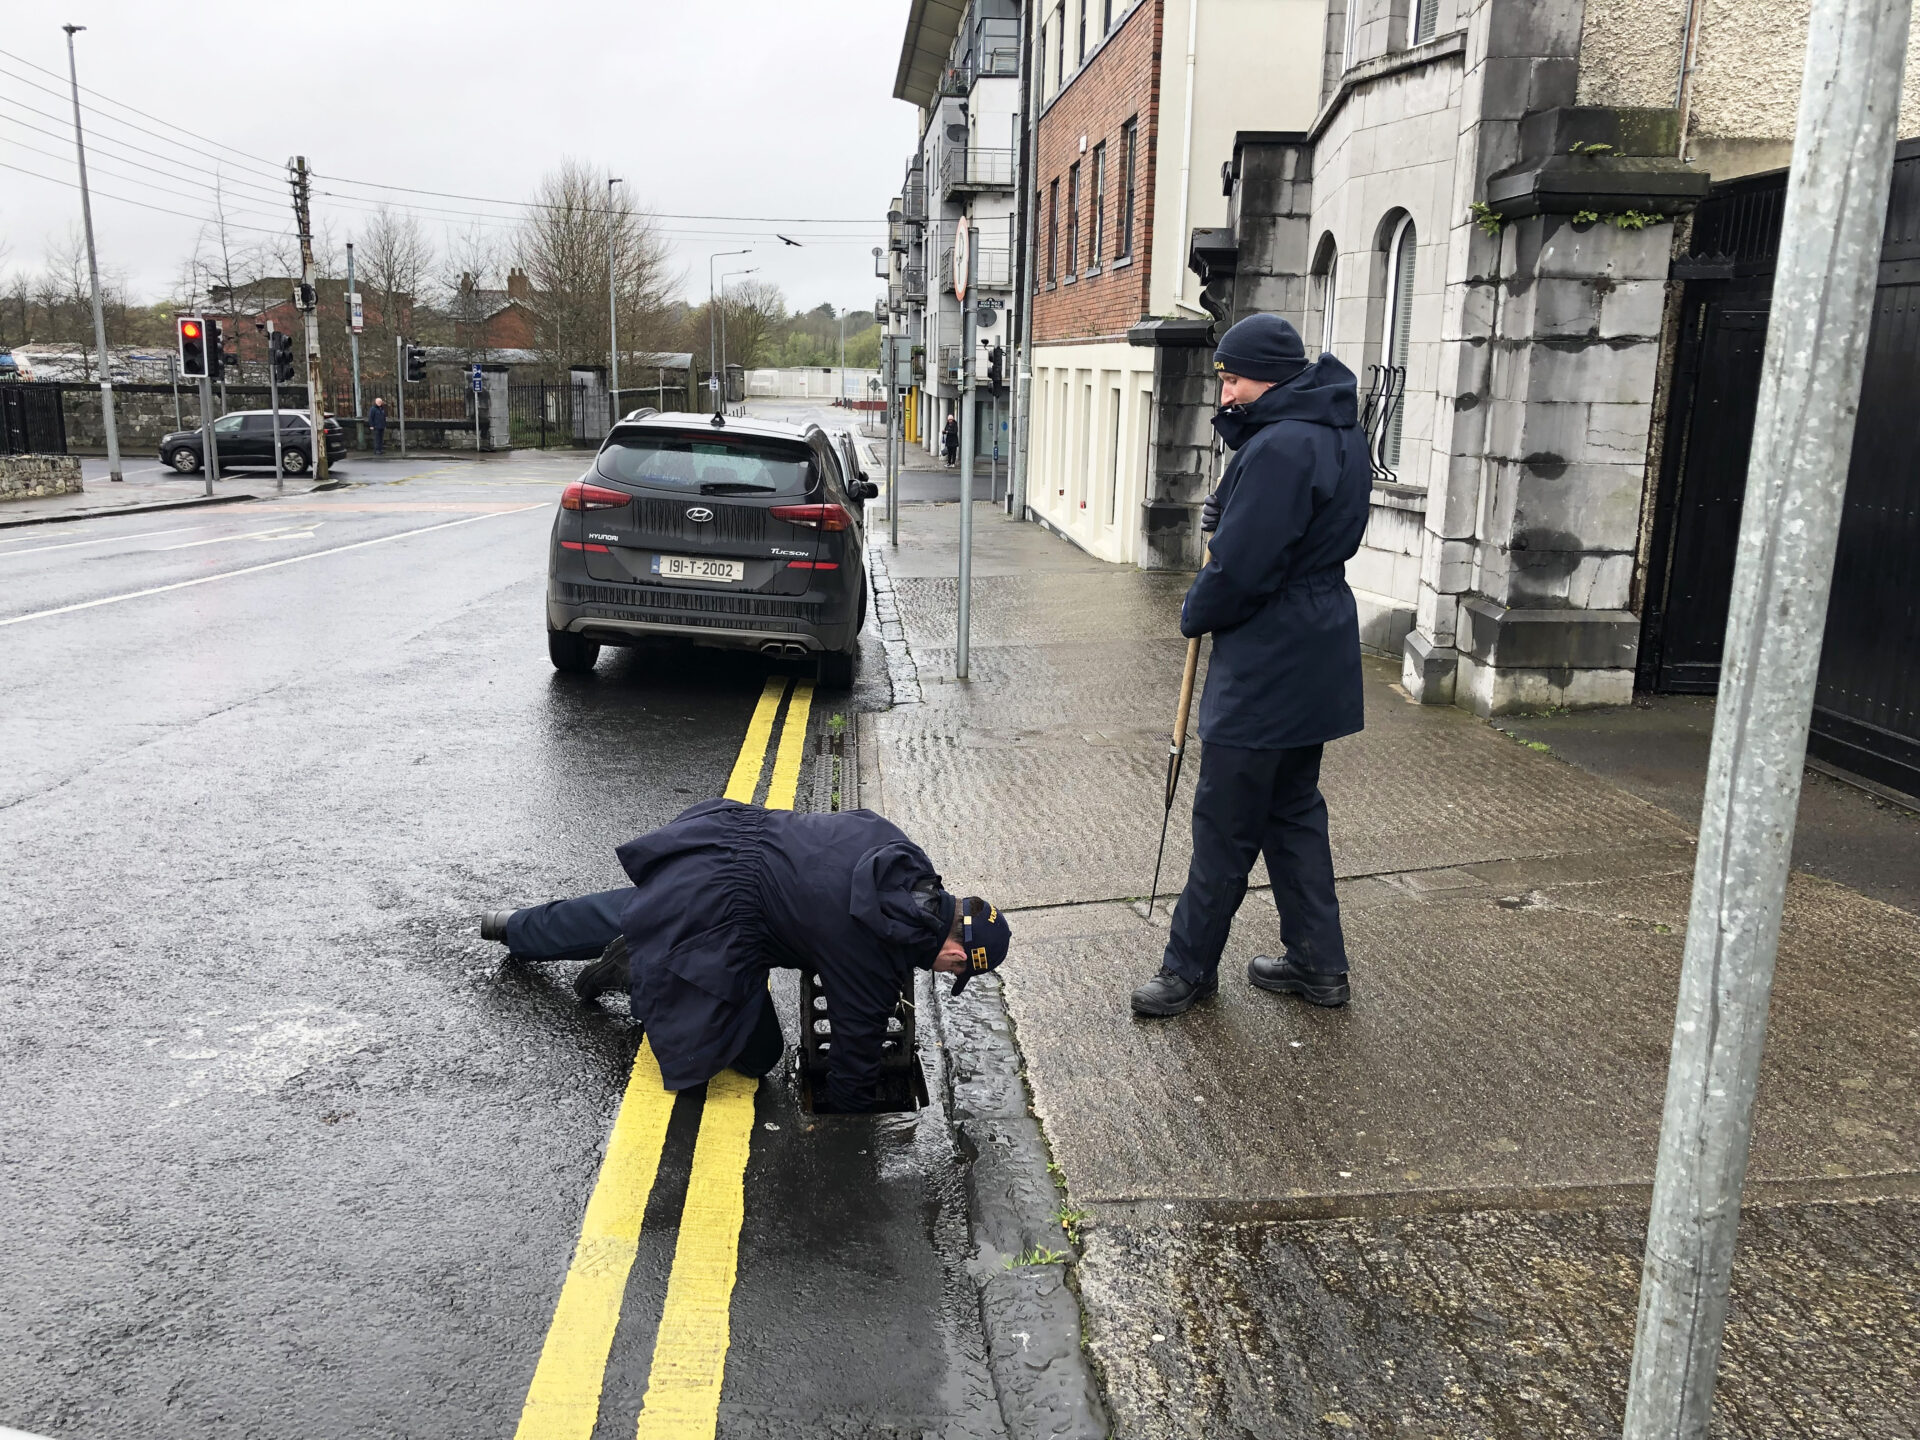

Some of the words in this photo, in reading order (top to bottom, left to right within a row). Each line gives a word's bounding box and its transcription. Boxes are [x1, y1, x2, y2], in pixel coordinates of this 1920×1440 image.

[588, 533, 619, 541] HYUNDAI
[771, 547, 809, 557] TUCSON
[669, 559, 733, 577] 191-T-2002
